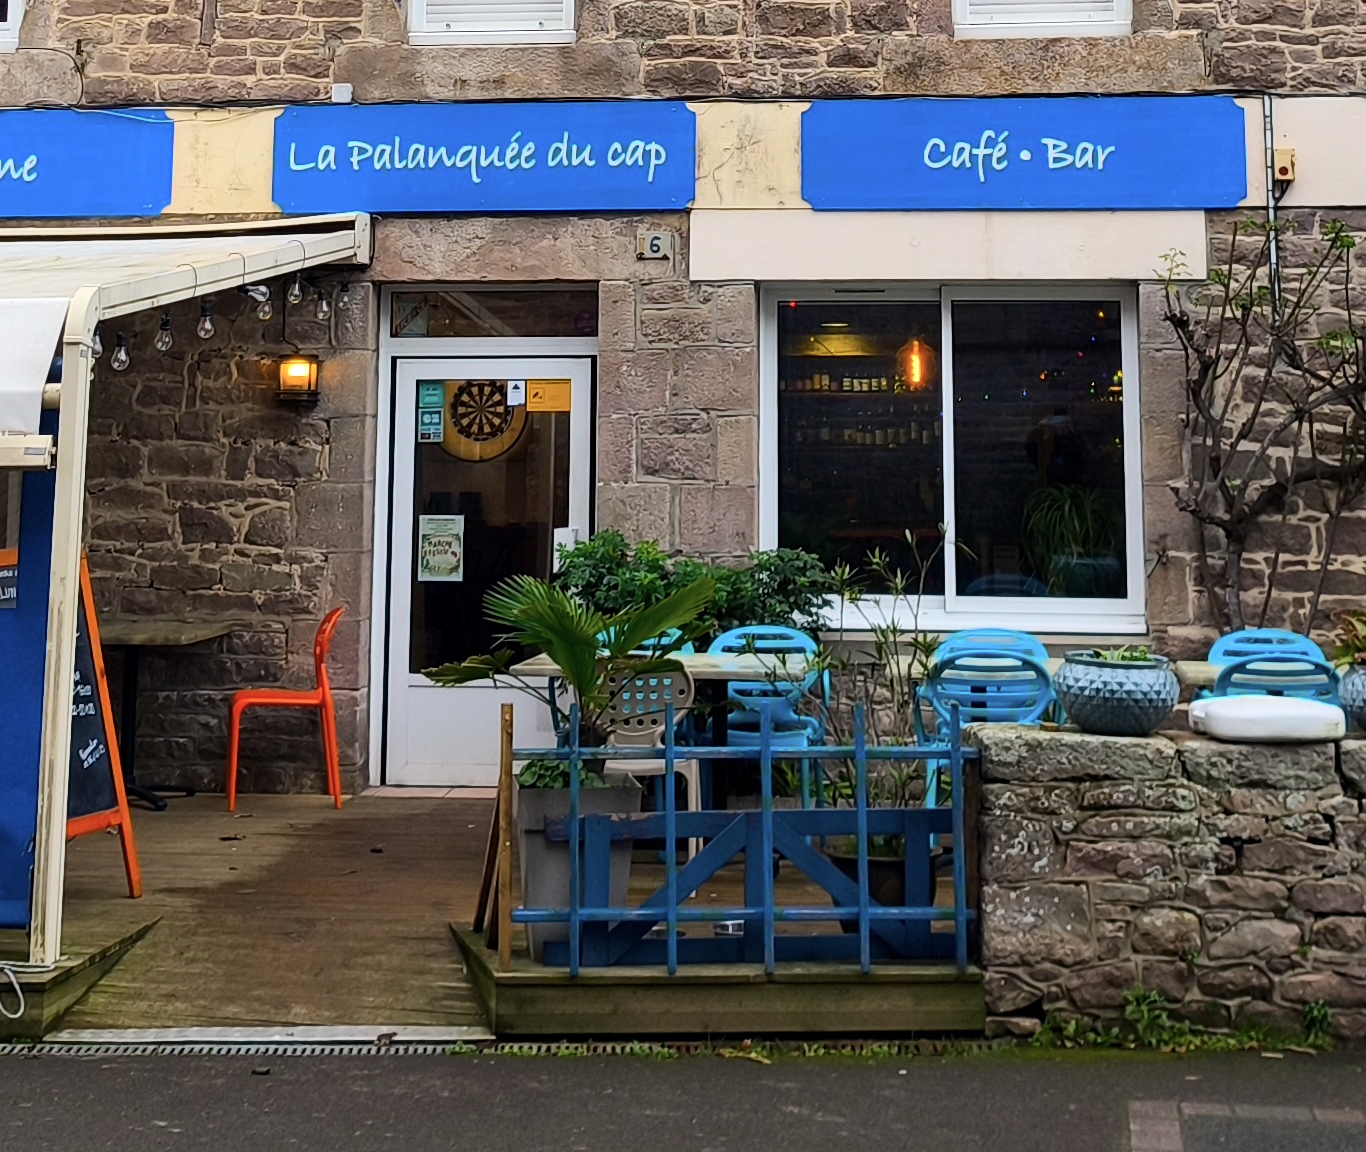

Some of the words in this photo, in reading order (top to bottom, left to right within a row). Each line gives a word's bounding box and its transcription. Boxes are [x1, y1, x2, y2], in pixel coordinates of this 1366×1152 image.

[289, 142, 337, 171] La
[347, 131, 536, 184] Palanquée
[547, 131, 596, 167] du
[607, 139, 667, 183] cap
[923, 129, 1009, 183] Café
[1040, 137, 1116, 170] Bar
[649, 235, 662, 254] 6
